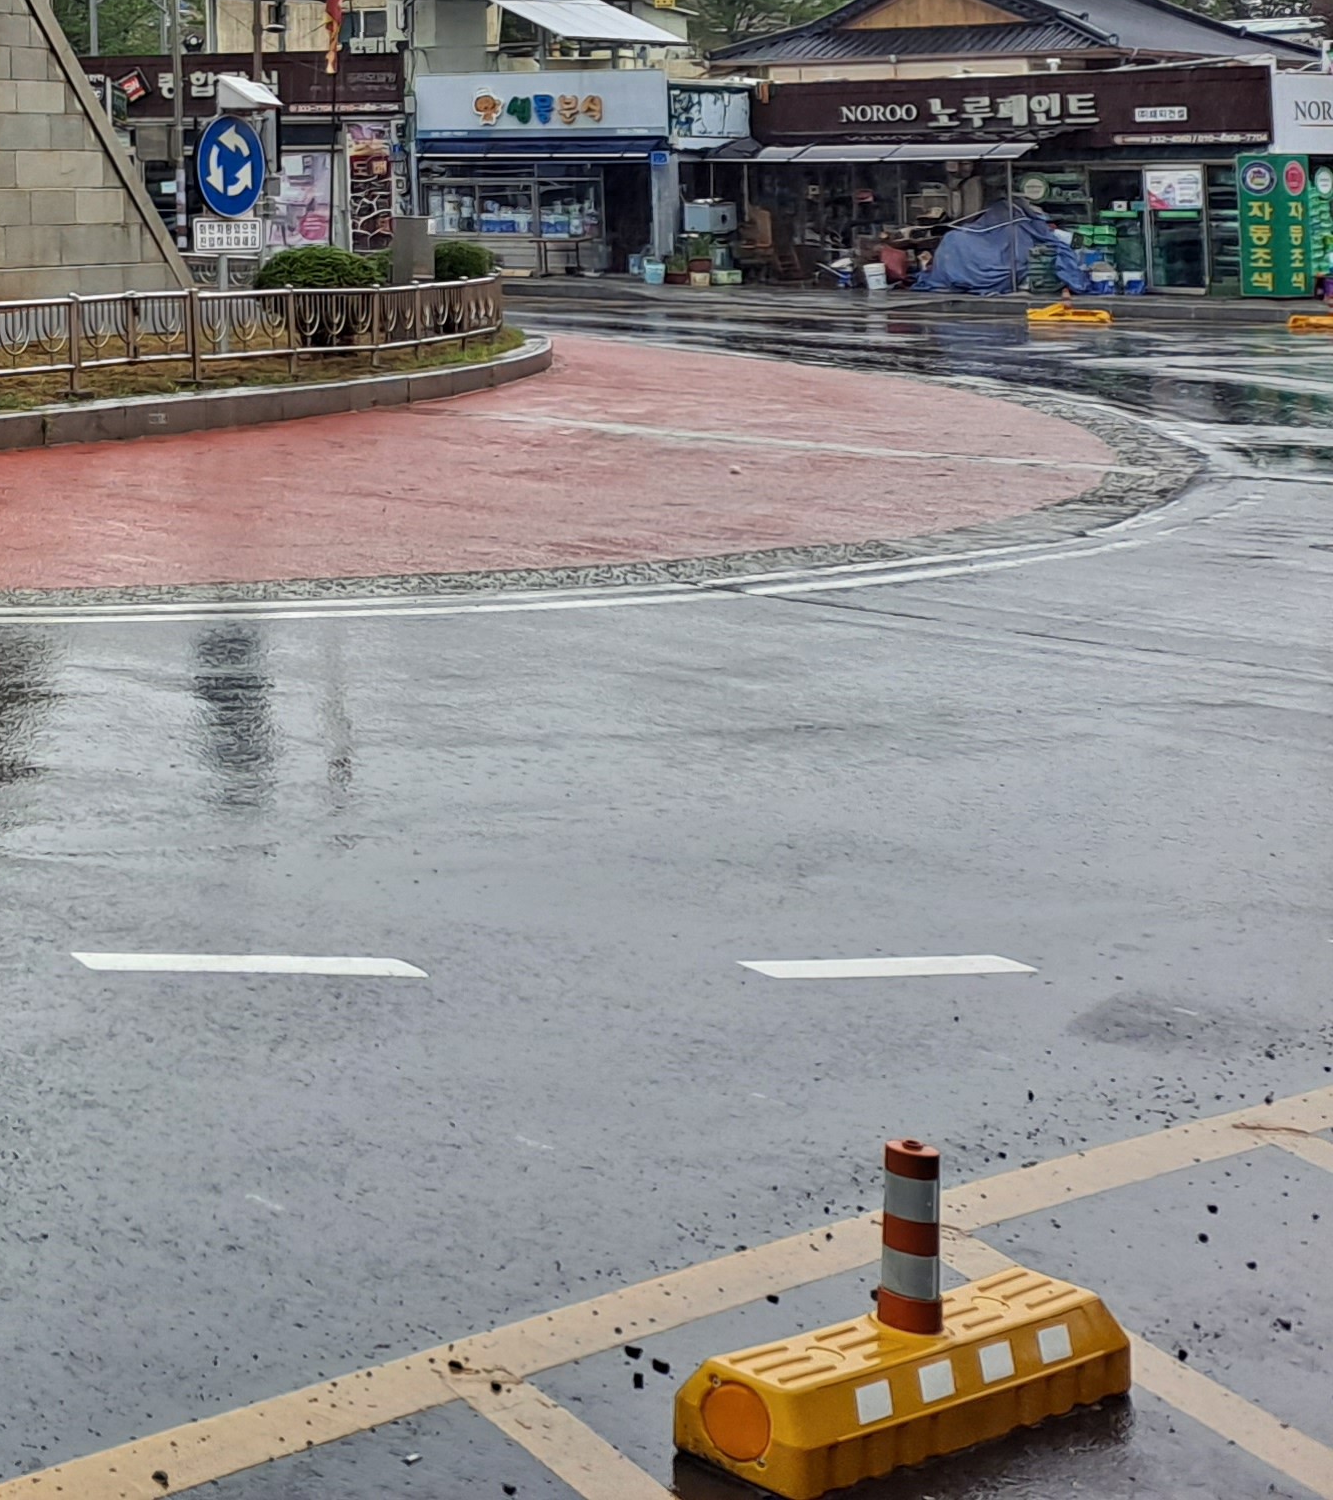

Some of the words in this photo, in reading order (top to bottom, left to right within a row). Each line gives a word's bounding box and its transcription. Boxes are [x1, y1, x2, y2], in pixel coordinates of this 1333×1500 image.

[839, 103, 918, 123] NOROO
[926, 92, 1101, 128] 노루페인트
[1247, 201, 1274, 292] 자동조색
[1287, 201, 1305, 292] 자동조색
